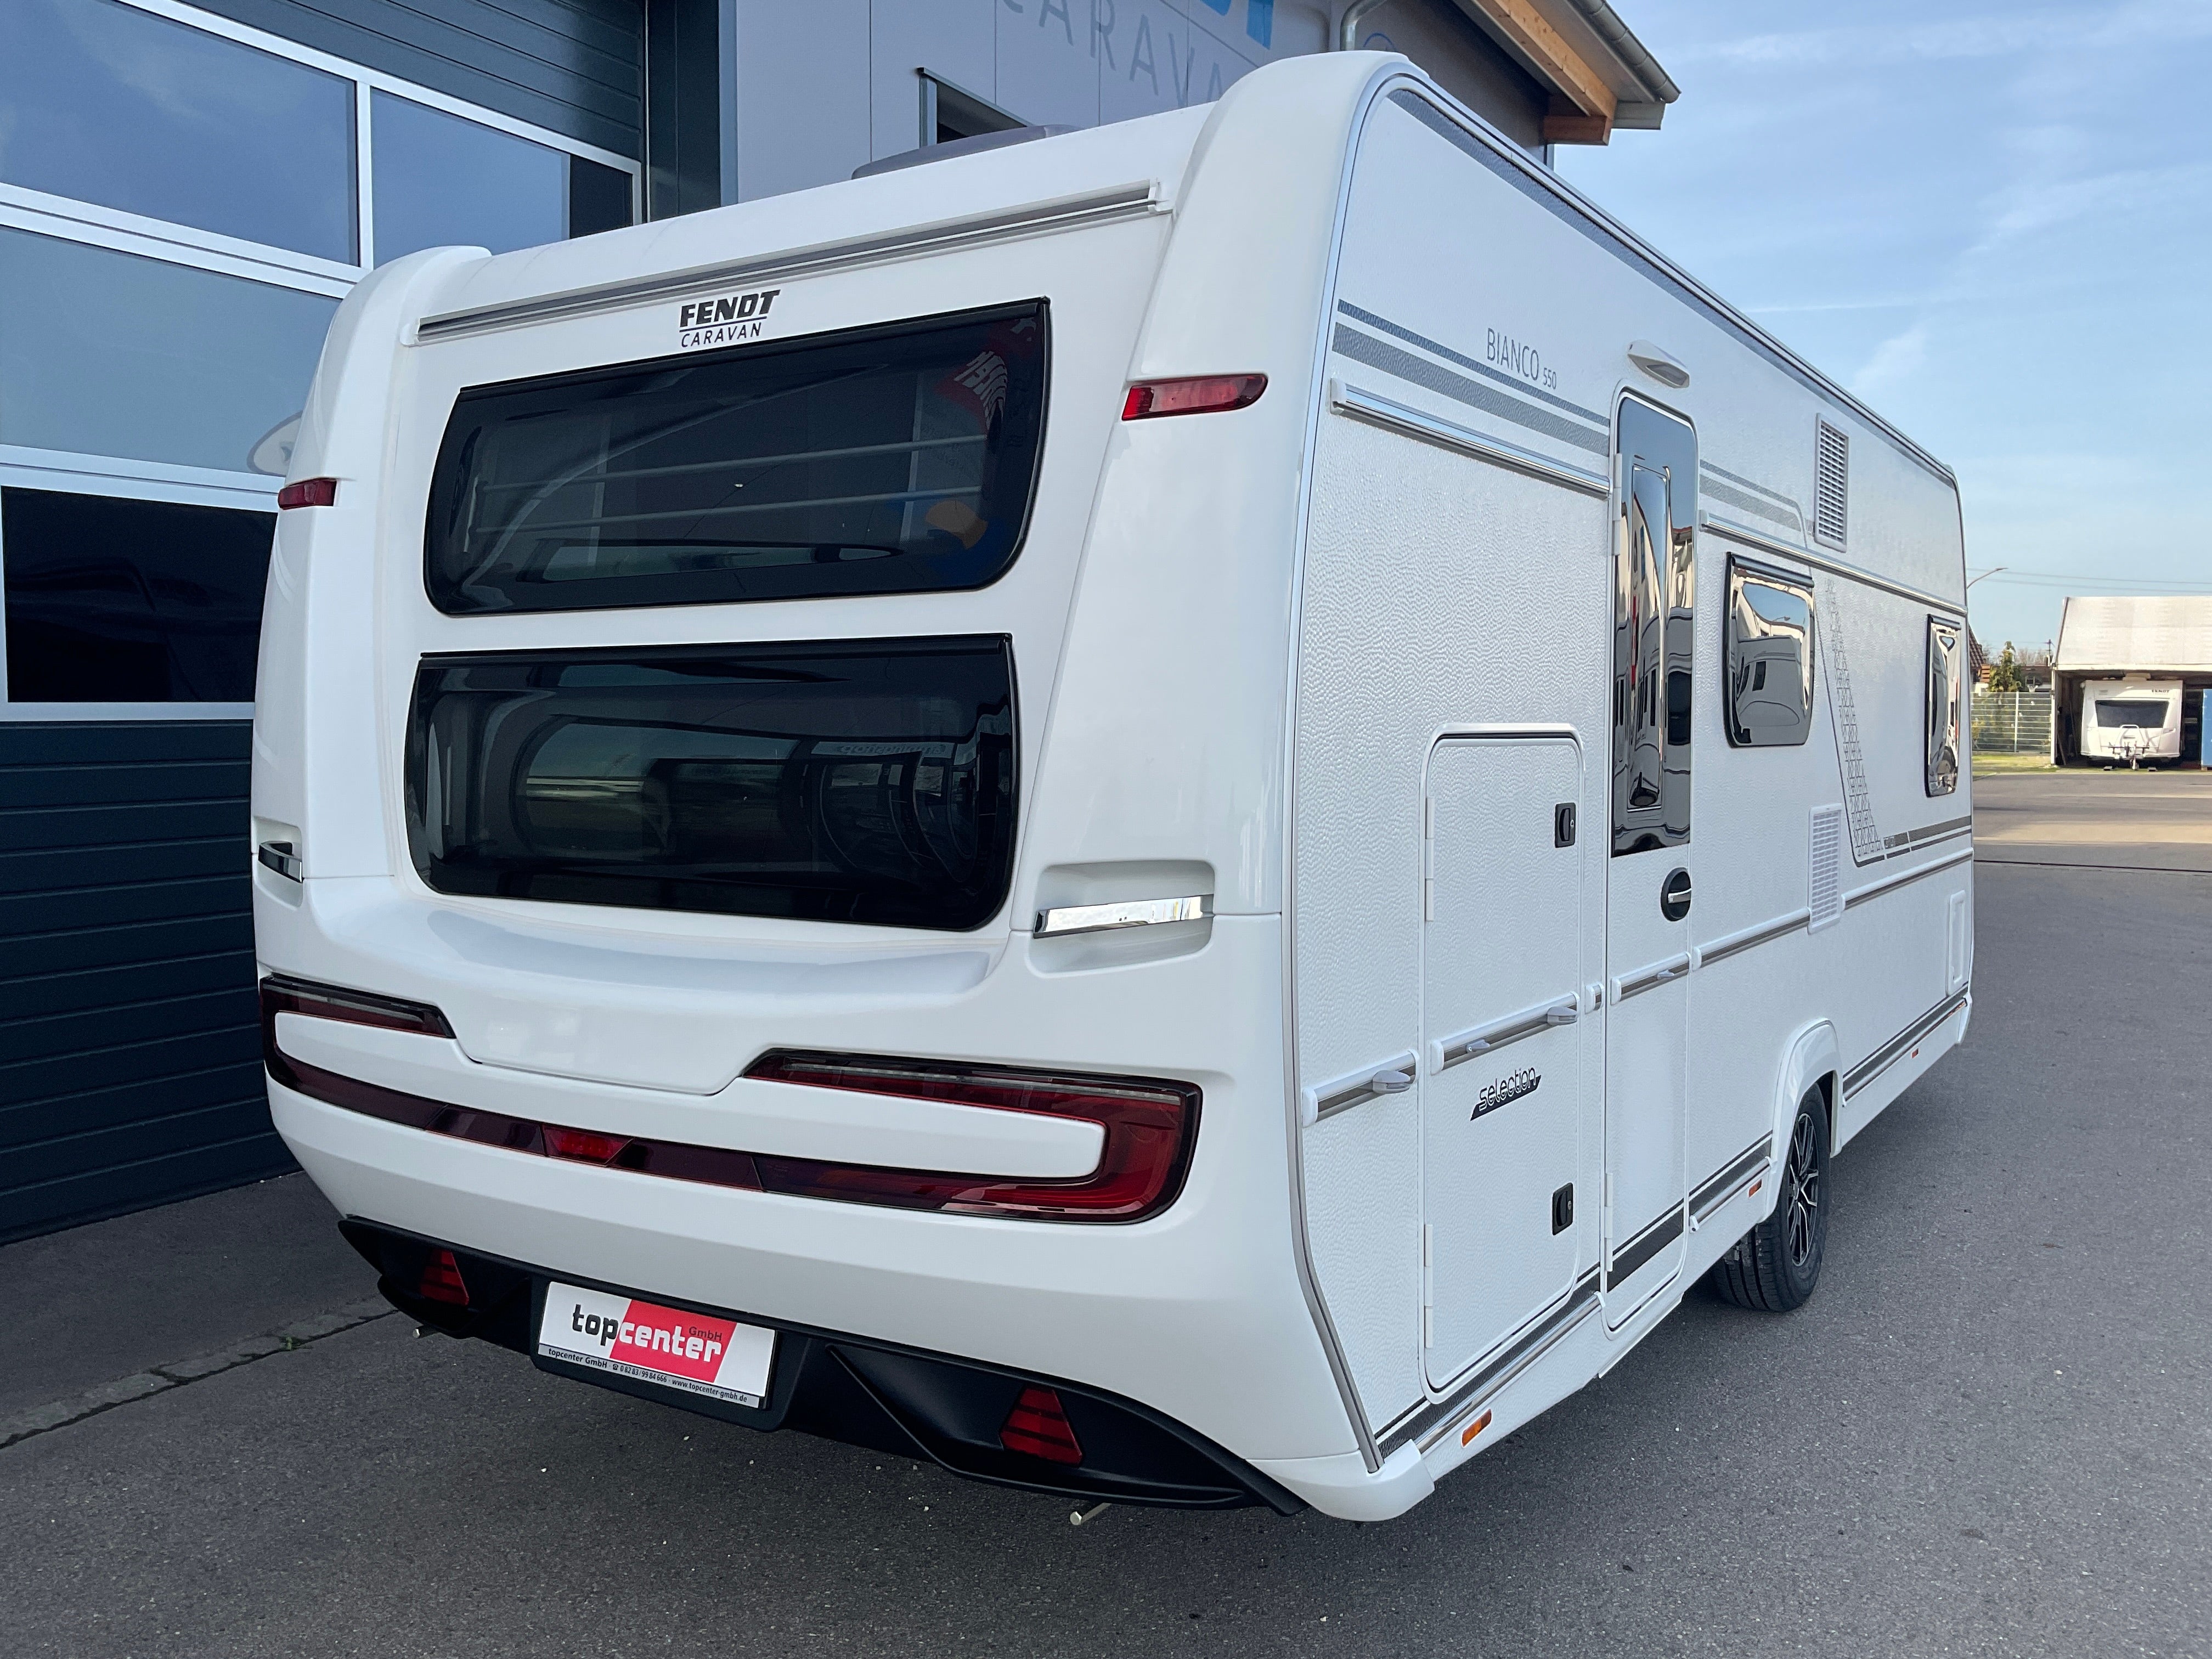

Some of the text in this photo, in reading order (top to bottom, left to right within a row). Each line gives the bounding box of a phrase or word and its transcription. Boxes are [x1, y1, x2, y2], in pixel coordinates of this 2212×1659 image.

[679, 289, 781, 328] FENDT
[681, 322, 761, 348] CARAVAN
[1487, 328, 1557, 390] BIANCO 550
[1479, 1066, 1537, 1111] selection
[689, 1326, 723, 1341] GmbH
[549, 1348, 583, 1362] topcenter
[585, 1357, 607, 1368] GmbH
[672, 1379, 747, 1402] www.topcenter-gmbh.de
